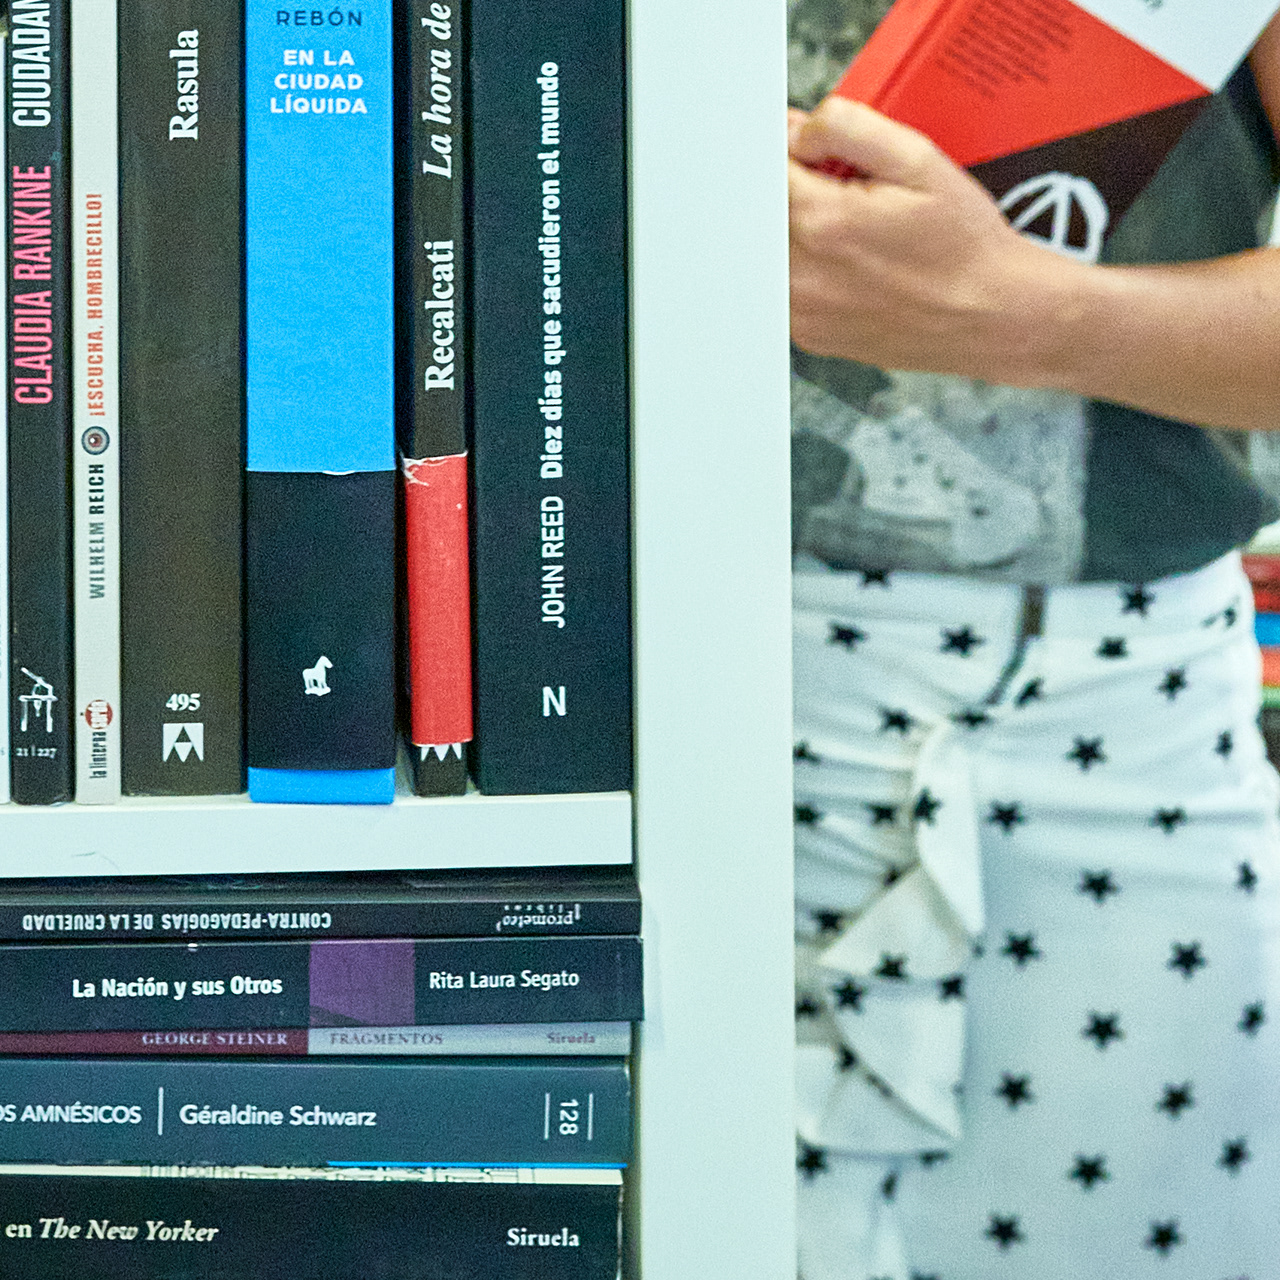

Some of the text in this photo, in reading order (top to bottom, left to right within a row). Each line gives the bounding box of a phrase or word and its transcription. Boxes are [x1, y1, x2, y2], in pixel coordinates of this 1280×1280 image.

[276, 7, 363, 26] REBÓN
[283, 50, 355, 67] EN LA
[170, 30, 199, 140] Rasula
[274, 73, 364, 90] CIUDAD
[423, 48, 453, 126] hora
[269, 93, 367, 116] LÍQUIDA
[423, 133, 453, 179] La
[14, 165, 51, 281] RANKINE
[424, 239, 454, 391] Recalcati
[14, 290, 53, 405] CLAUDIA
[537, 61, 566, 628] JOHN REED Diez días que sacudieron el mundo
[90, 463, 106, 600] WILHELM REICH
[166, 693, 201, 710] 495
[72, 975, 283, 1000] La Nación y sus Otros
[429, 969, 580, 990] Rita Laura Segato
[142, 1032, 211, 1047] GEORGE
[217, 1031, 288, 1046] STEINER
[21, 1101, 141, 1123] AMNÉSICOS
[179, 1104, 283, 1126] Géraldine
[290, 1105, 376, 1127] Schwarz
[560, 1098, 579, 1135] 128
[5, 1221, 32, 1237] en
[39, 1219, 80, 1239] The
[85, 1220, 138, 1240] New
[145, 1220, 219, 1243] Yorker
[507, 1227, 580, 1247] Siruela
